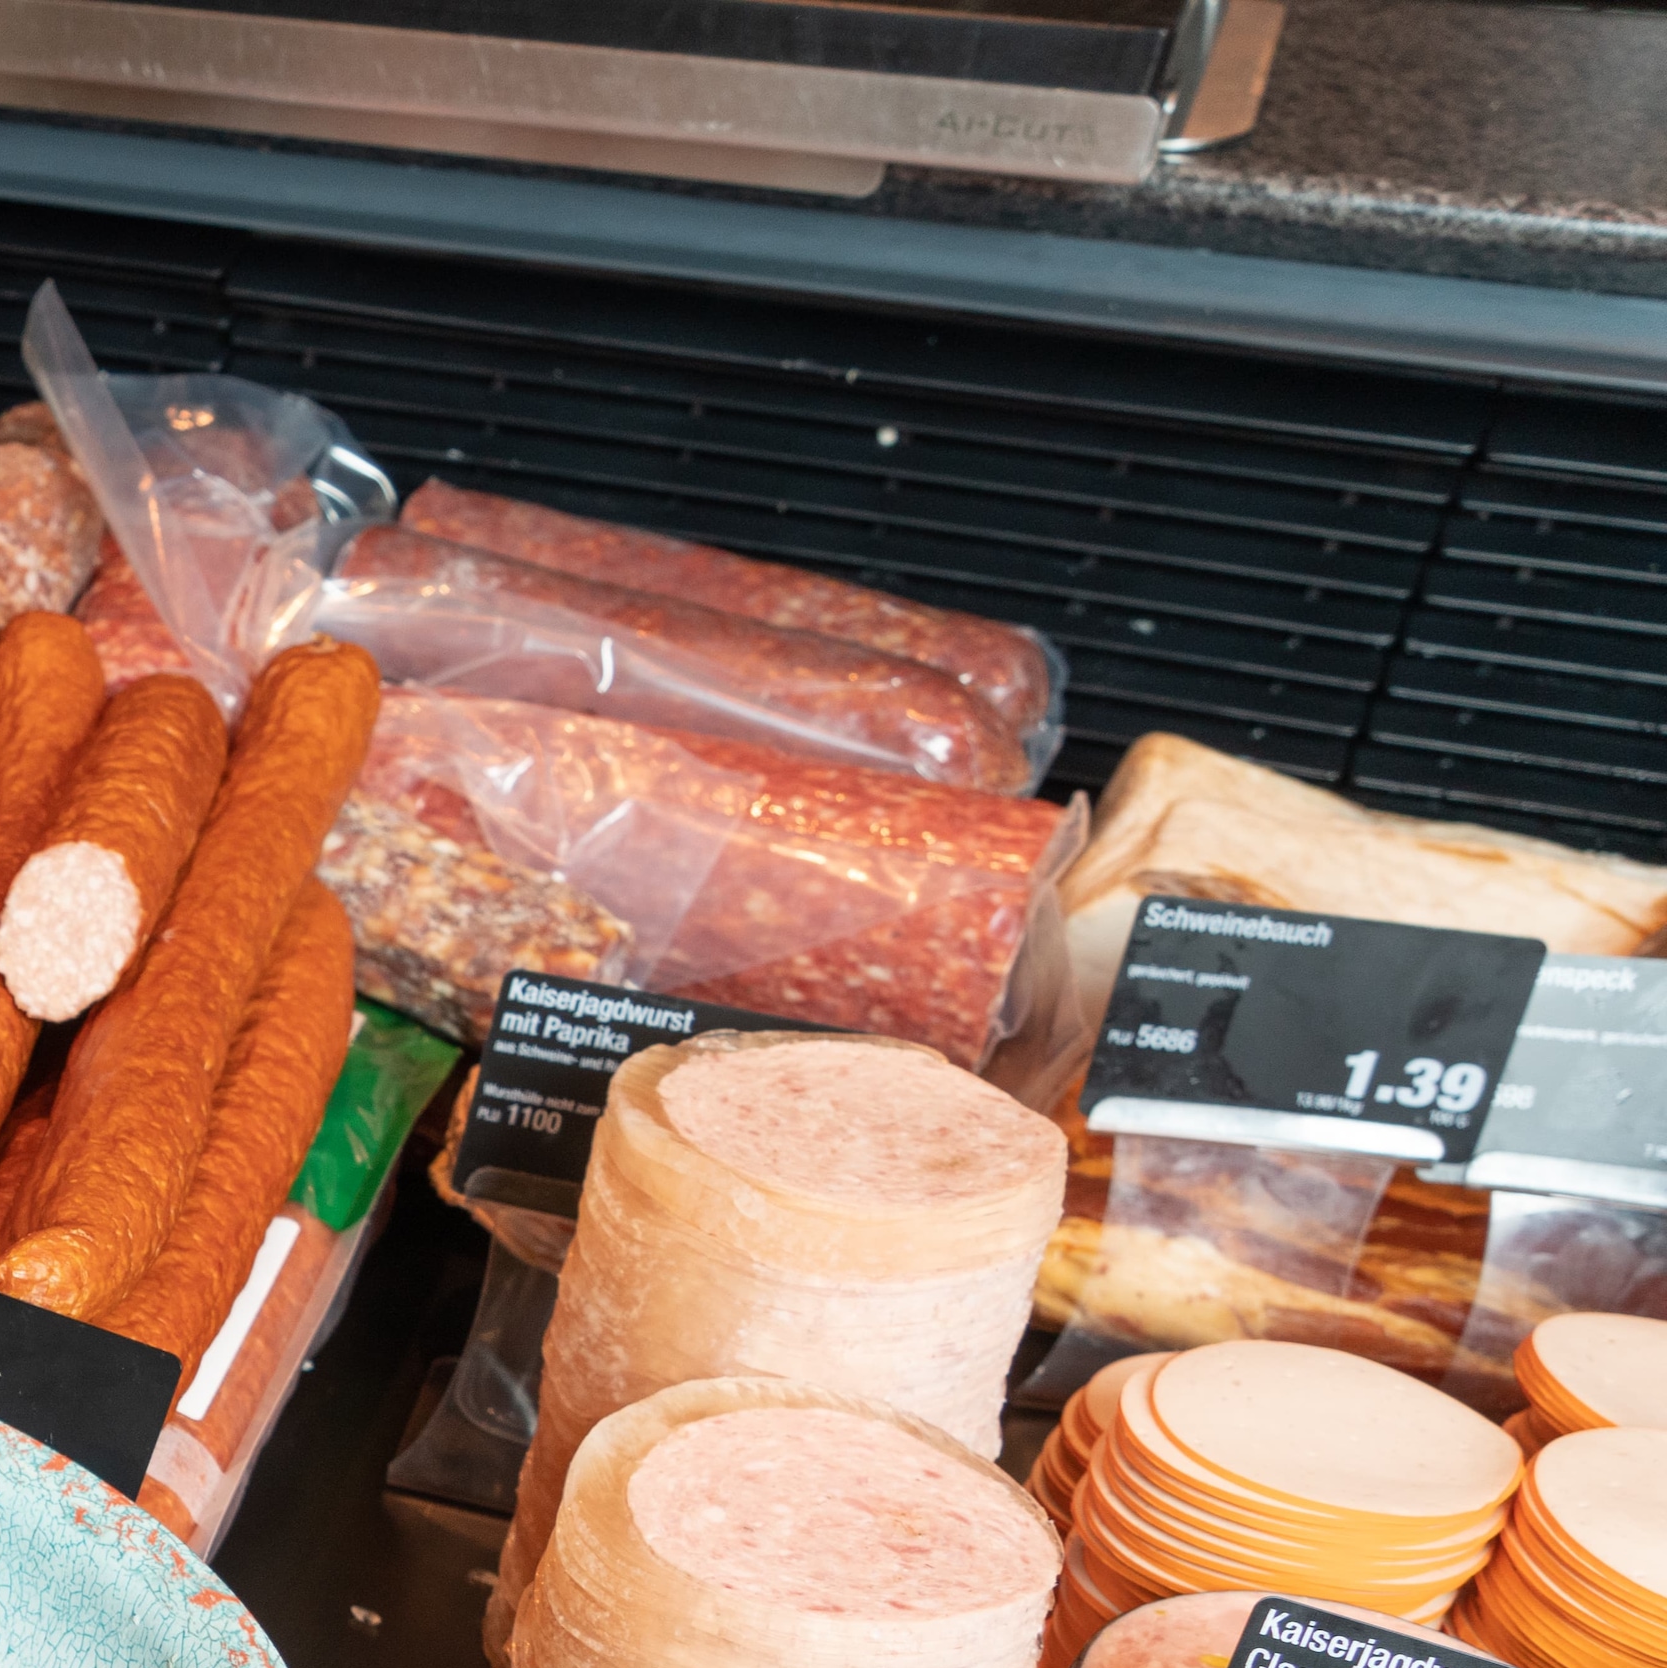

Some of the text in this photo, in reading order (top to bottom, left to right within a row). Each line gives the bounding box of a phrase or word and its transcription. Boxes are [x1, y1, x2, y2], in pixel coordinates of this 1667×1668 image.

[1140, 899, 1332, 946] Schweinebauch
[507, 977, 694, 1033] Kaiserjagdwurst
[499, 1011, 633, 1057] mit Paprika
[1106, 1024, 1198, 1053] PLU 5686
[1343, 1050, 1486, 1115] 1.39
[474, 1103, 562, 1134] PLU 1100
